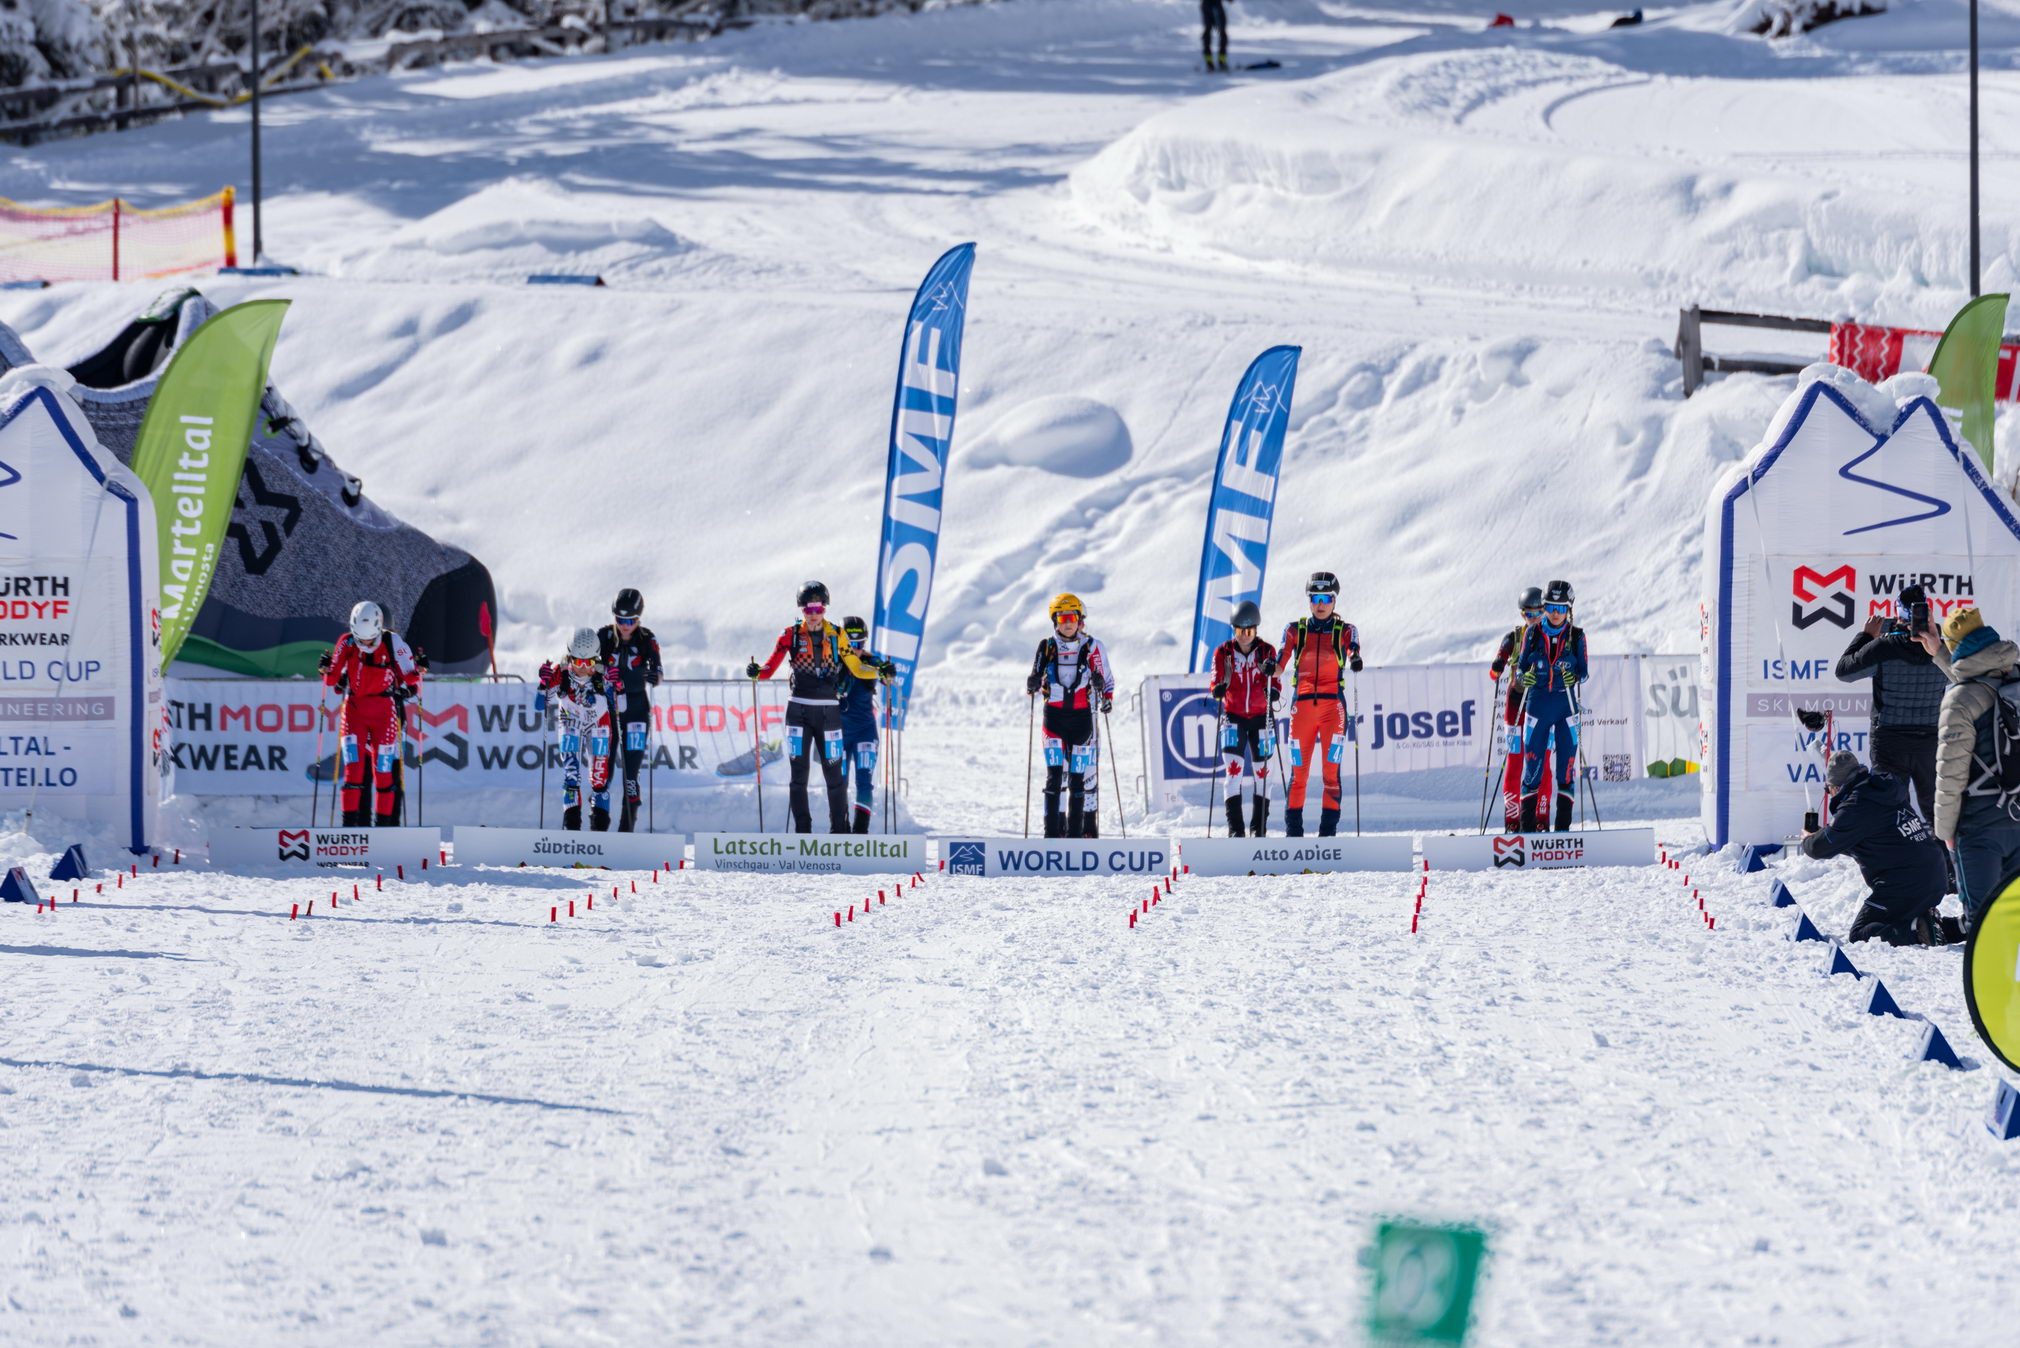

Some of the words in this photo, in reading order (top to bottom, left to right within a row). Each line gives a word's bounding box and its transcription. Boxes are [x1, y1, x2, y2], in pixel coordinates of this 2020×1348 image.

[875, 320, 956, 661] ISMF
[161, 415, 214, 619] Martelltal
[47, 660, 100, 682] CUP
[1763, 659, 1829, 680] ISMF
[1805, 699, 1871, 712] MOUN
[1371, 699, 1476, 750] josef
[1787, 763, 1827, 782] VA
[1897, 818, 1922, 837] ISMF
[316, 834, 369, 845] WÜRTH
[1531, 838, 1583, 850] WÜRTH
[316, 846, 369, 856] MODYF
[1531, 850, 1584, 861] MODYF
[714, 859, 769, 872] Vinschgau
[779, 860, 795, 871] Val
[798, 860, 841, 871] Venosta
[952, 864, 983, 875] ISMF
[998, 850, 1099, 871] WORLD
[1108, 850, 1164, 872] CUP
